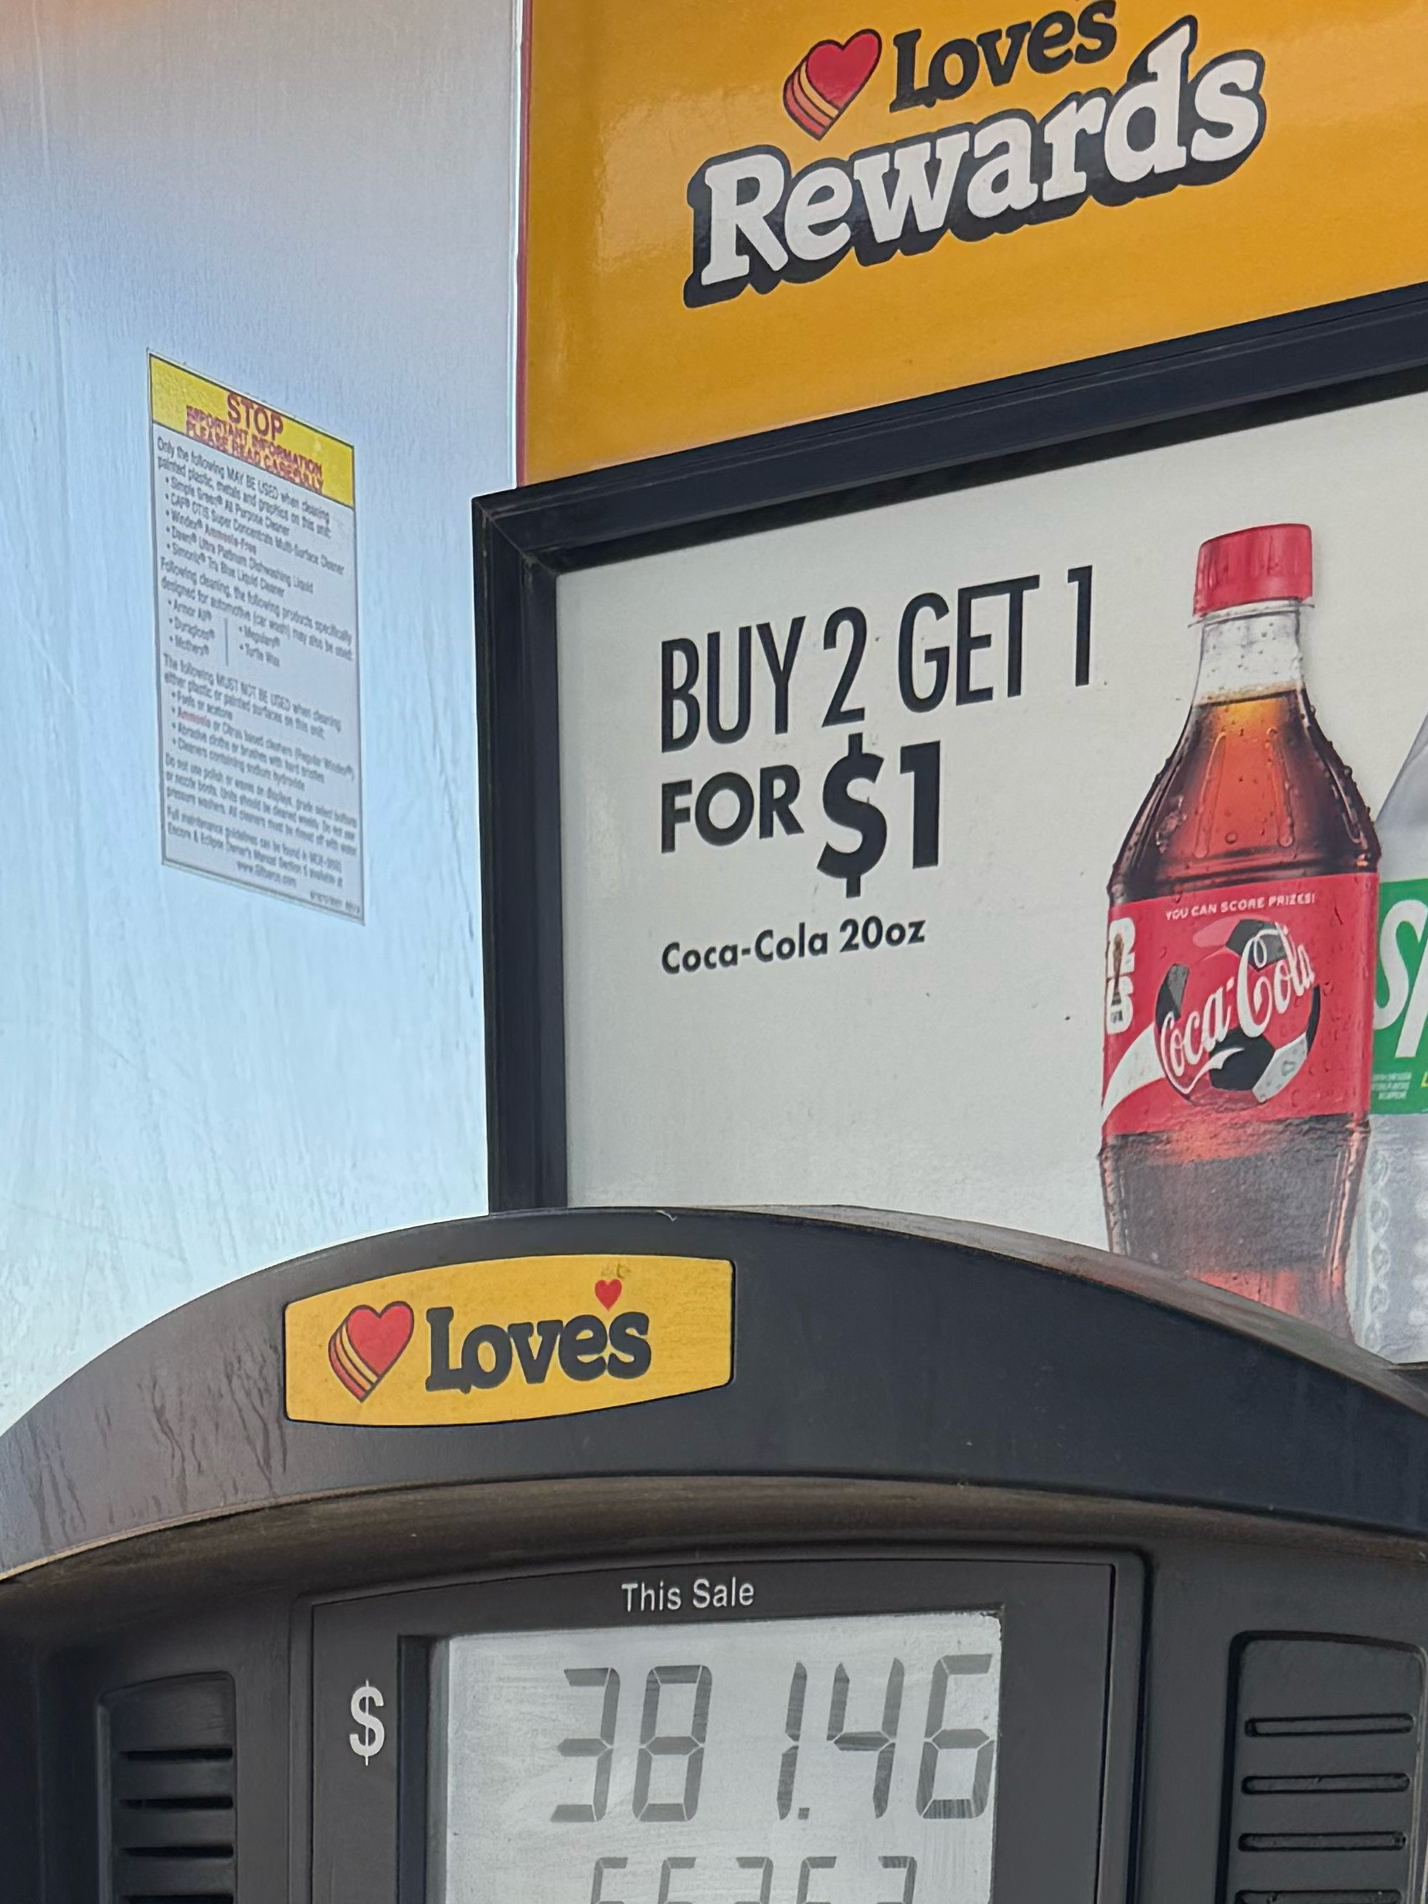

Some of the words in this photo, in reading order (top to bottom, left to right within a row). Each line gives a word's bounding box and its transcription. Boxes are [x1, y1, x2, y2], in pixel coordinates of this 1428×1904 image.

[688, 18, 1266, 307] Rewards
[227, 392, 284, 441] STOP
[661, 616, 806, 753] BUY
[821, 606, 867, 728] 2
[897, 574, 1040, 713] GET
[1067, 565, 1093, 687] 1
[661, 763, 804, 854] FOR
[816, 732, 941, 898] $1
[661, 922, 828, 974] Coca-Cola
[839, 915, 926, 952] 20oz
[1166, 908, 1189, 921] YOU
[1191, 904, 1216, 917] CAN
[1221, 897, 1264, 913] SCORE
[1268, 892, 1315, 908] PRIZES!
[1160, 922, 1315, 1077] Coca-Cola
[621, 1582, 683, 1612] This
[692, 1578, 755, 1608] Sale
[348, 1680, 386, 1766] $
[549, 1653, 996, 1823] 381.46
